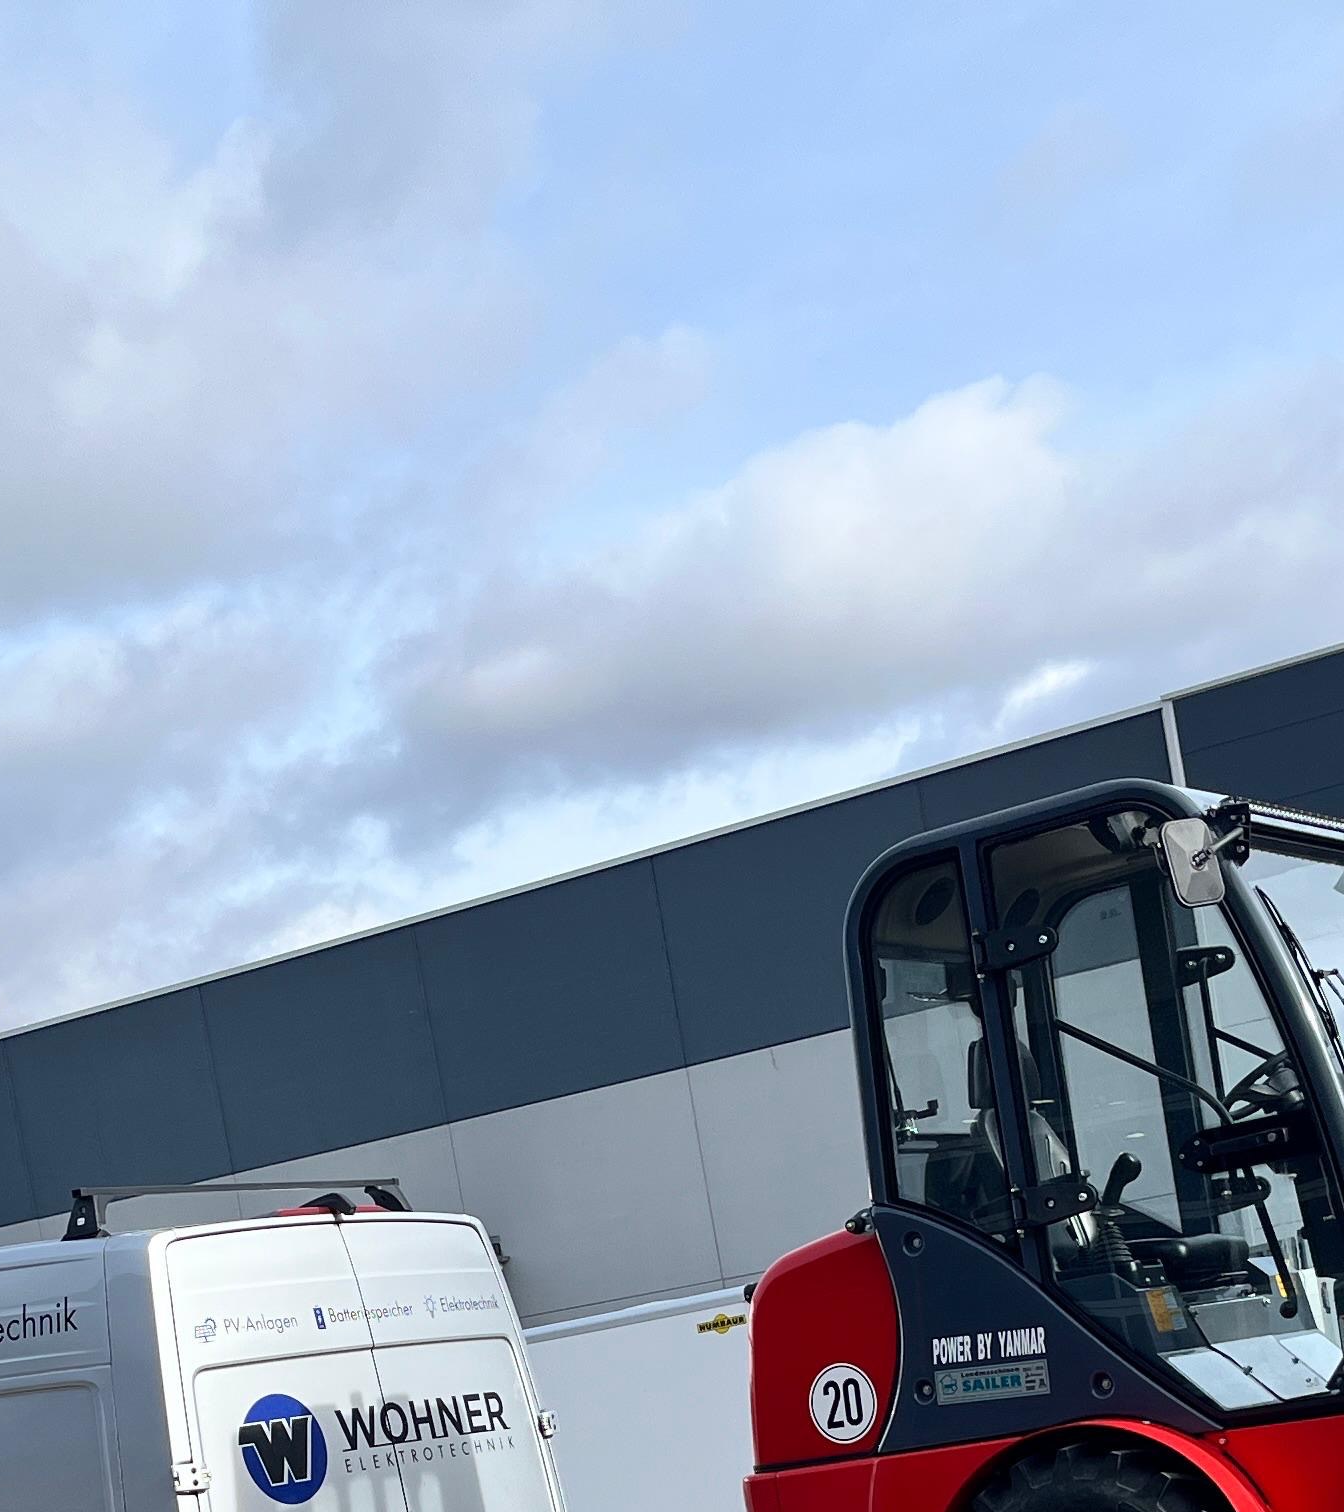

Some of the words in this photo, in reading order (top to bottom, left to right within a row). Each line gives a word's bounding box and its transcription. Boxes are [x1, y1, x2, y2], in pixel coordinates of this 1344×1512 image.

[223, 1314, 299, 1335] PV-Anlagen
[328, 1303, 414, 1323] Batteriespeicher
[440, 1295, 500, 1312] Elektrotechnik
[698, 1315, 746, 1333] HUMBAUR
[932, 1335, 972, 1365] POWER
[977, 1332, 992, 1360] BY
[998, 1326, 1046, 1358] YANMAR
[962, 1374, 1022, 1392] SAILER
[334, 1391, 511, 1453] WOHNER
[822, 1377, 864, 1430] 20
[345, 1435, 516, 1473] ELEKTROTECHNIK
